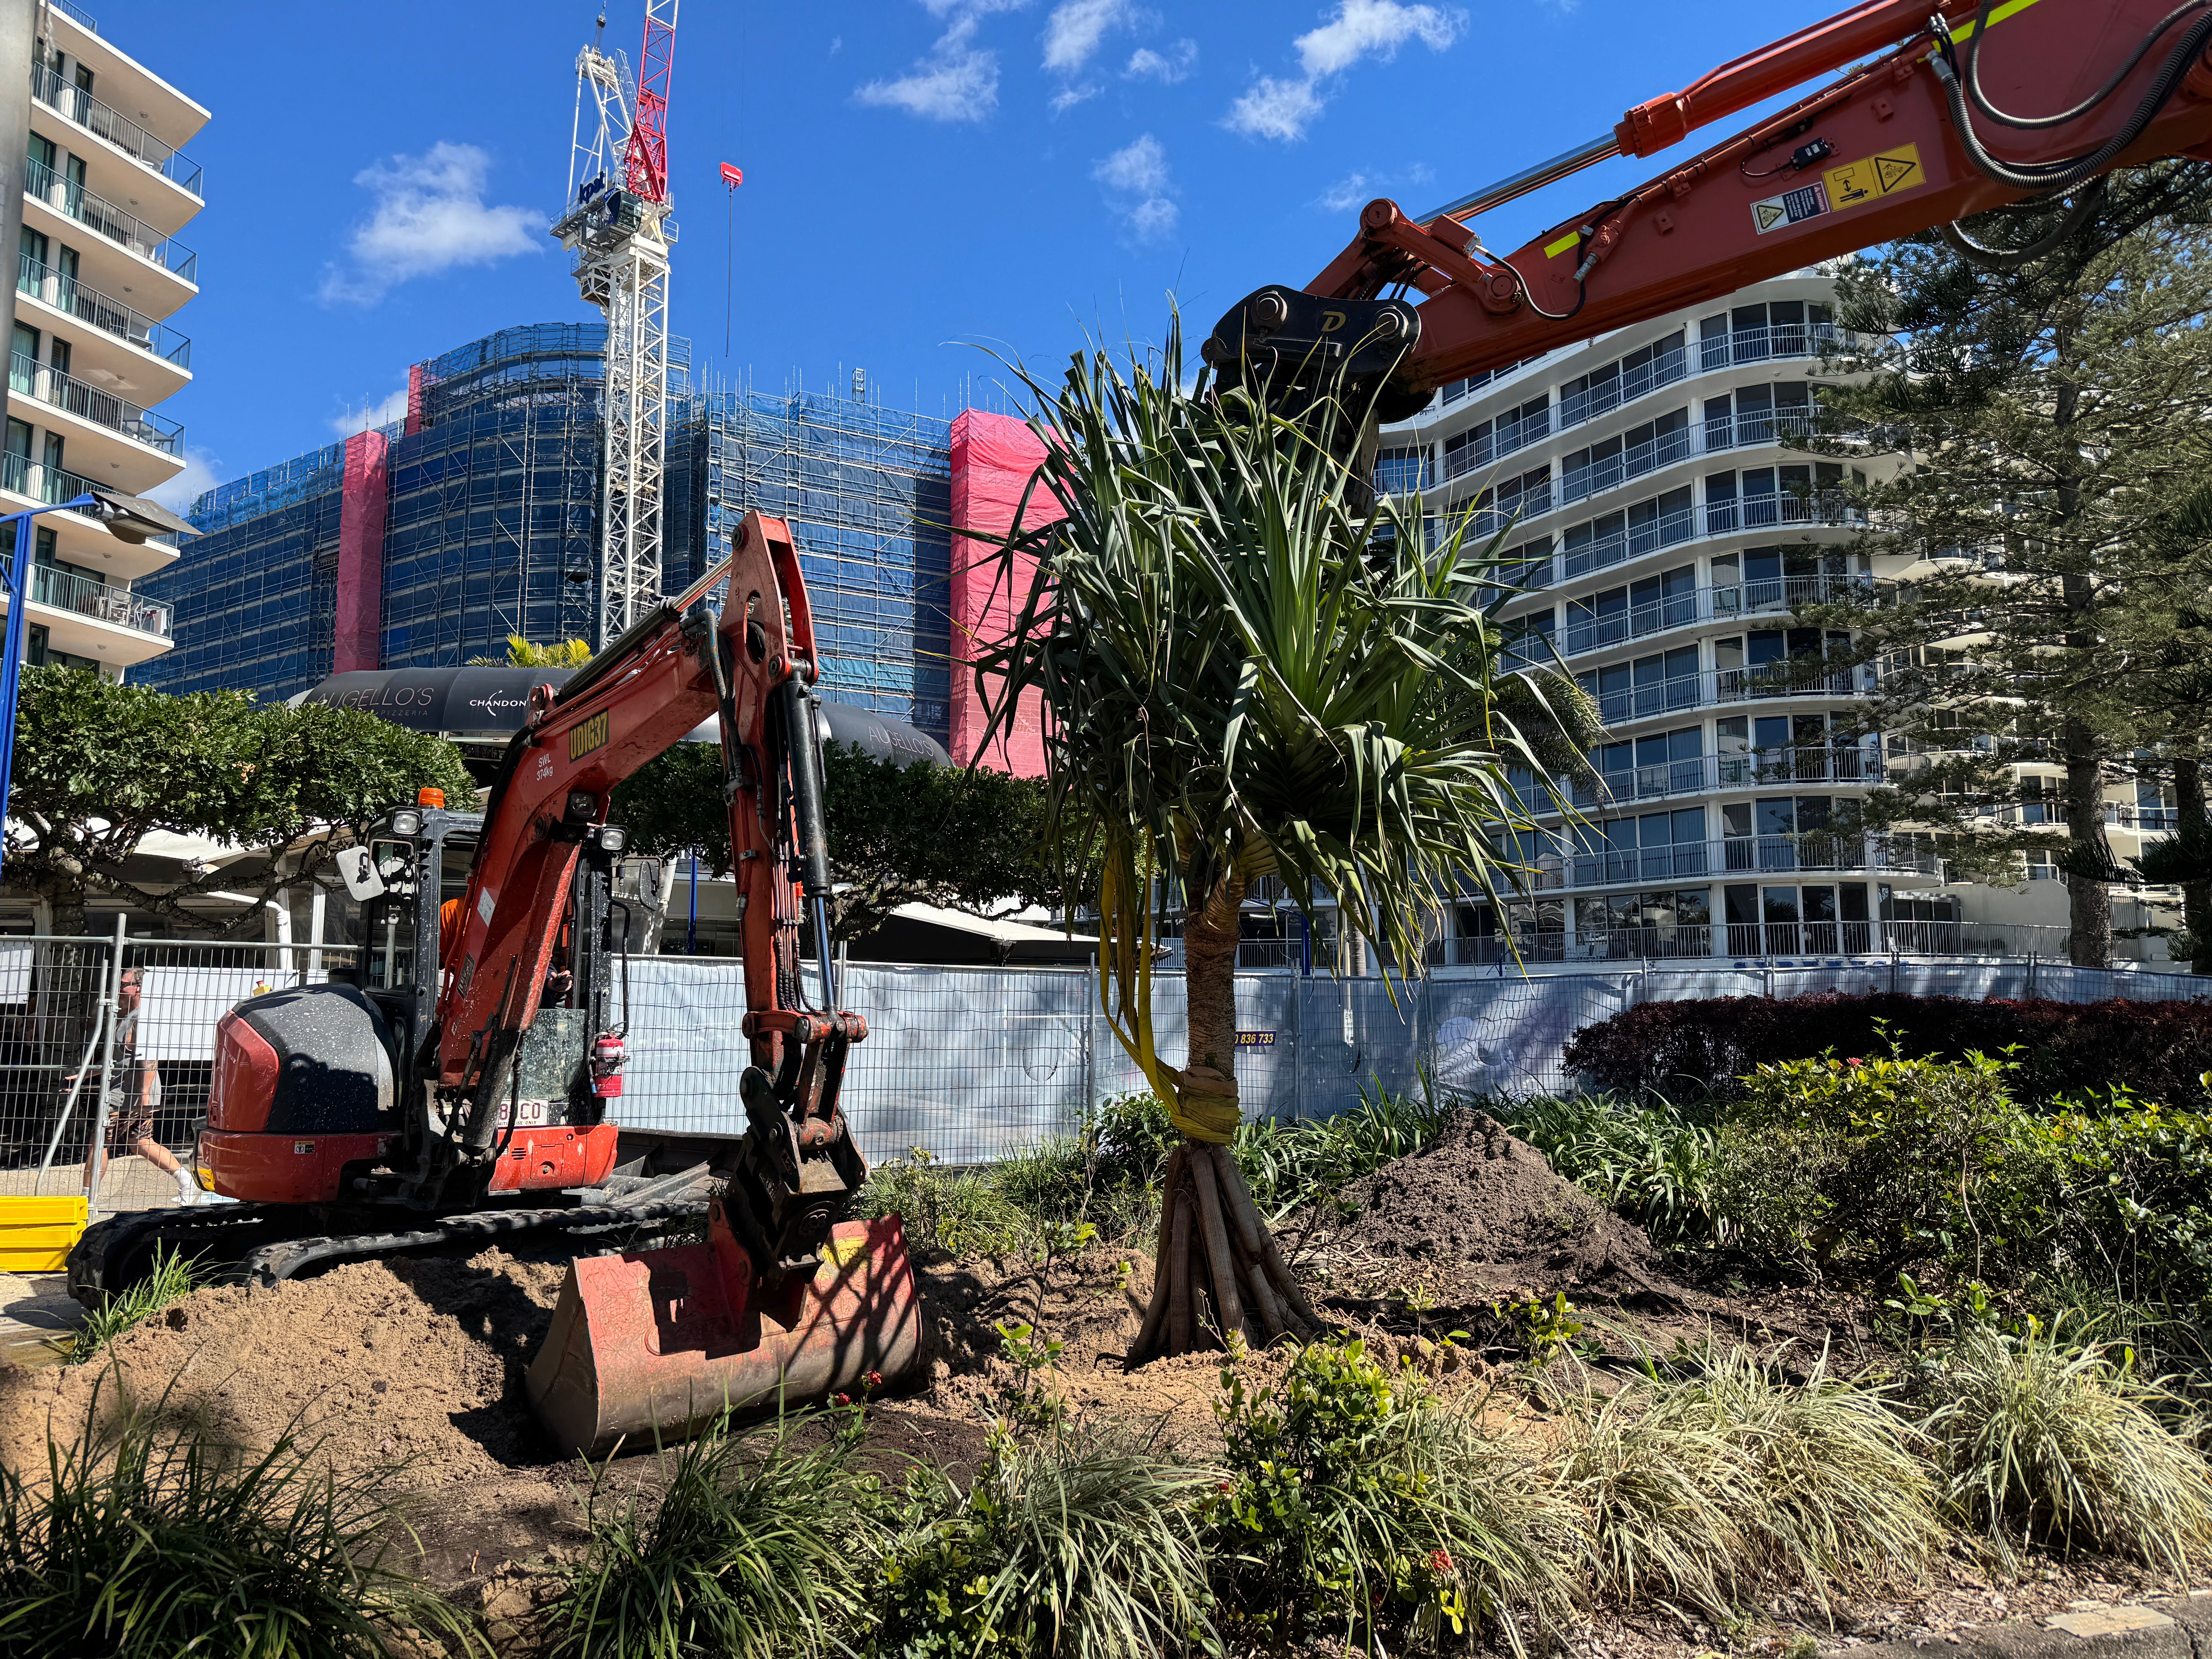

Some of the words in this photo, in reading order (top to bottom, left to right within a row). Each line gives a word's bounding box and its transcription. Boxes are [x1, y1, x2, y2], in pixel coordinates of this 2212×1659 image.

[1817, 193, 1825, 211] DANGER
[1321, 311, 1346, 332] D
[315, 688, 433, 709] AUGELLO'S
[570, 711, 608, 759] UDIG37
[539, 753, 551, 767] SWL
[537, 766, 553, 781] 374kg
[1240, 1034, 1257, 1044] 836
[1259, 1033, 1274, 1044] 733
